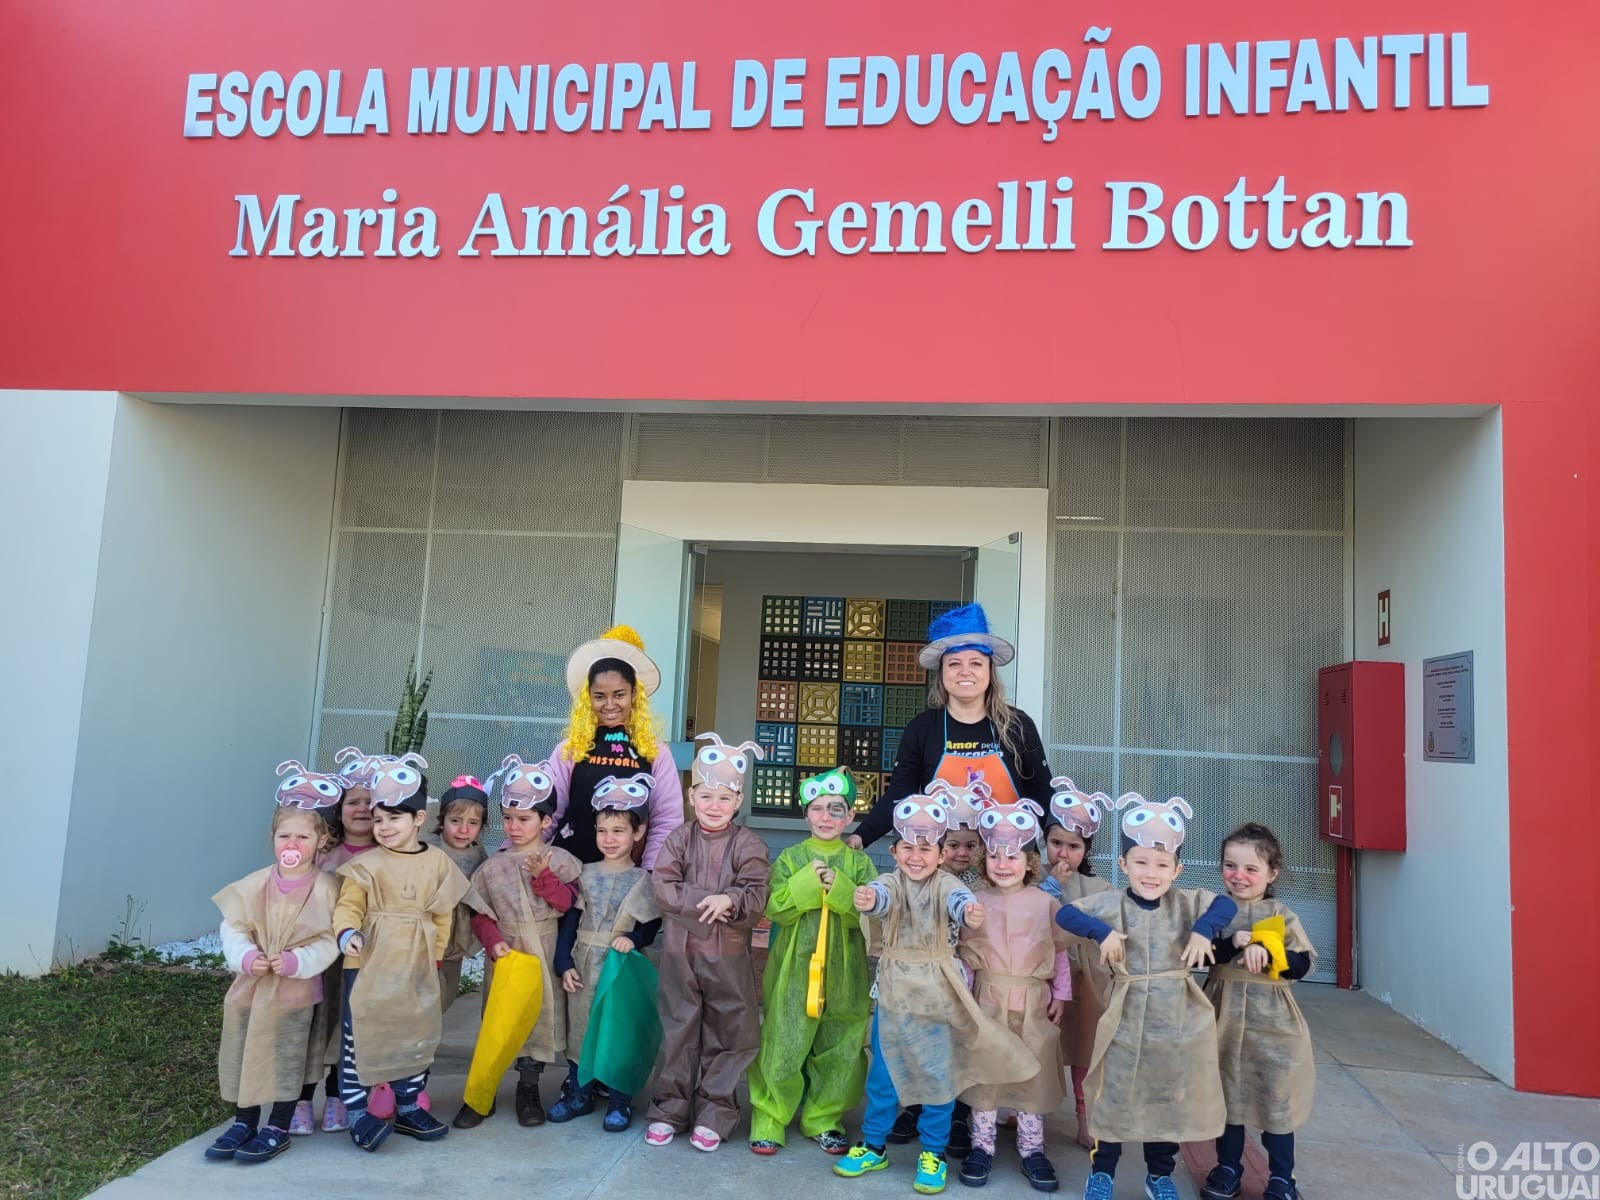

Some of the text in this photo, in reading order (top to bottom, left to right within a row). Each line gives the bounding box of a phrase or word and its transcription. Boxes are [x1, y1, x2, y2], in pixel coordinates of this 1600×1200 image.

[183, 26, 1491, 142] ESCOLA MUNICIPAL DE EDUCAÇÃO INFANTIL
[228, 176, 1414, 258] Maria Amália Gemelli Bottan
[946, 740, 979, 750] Amor
